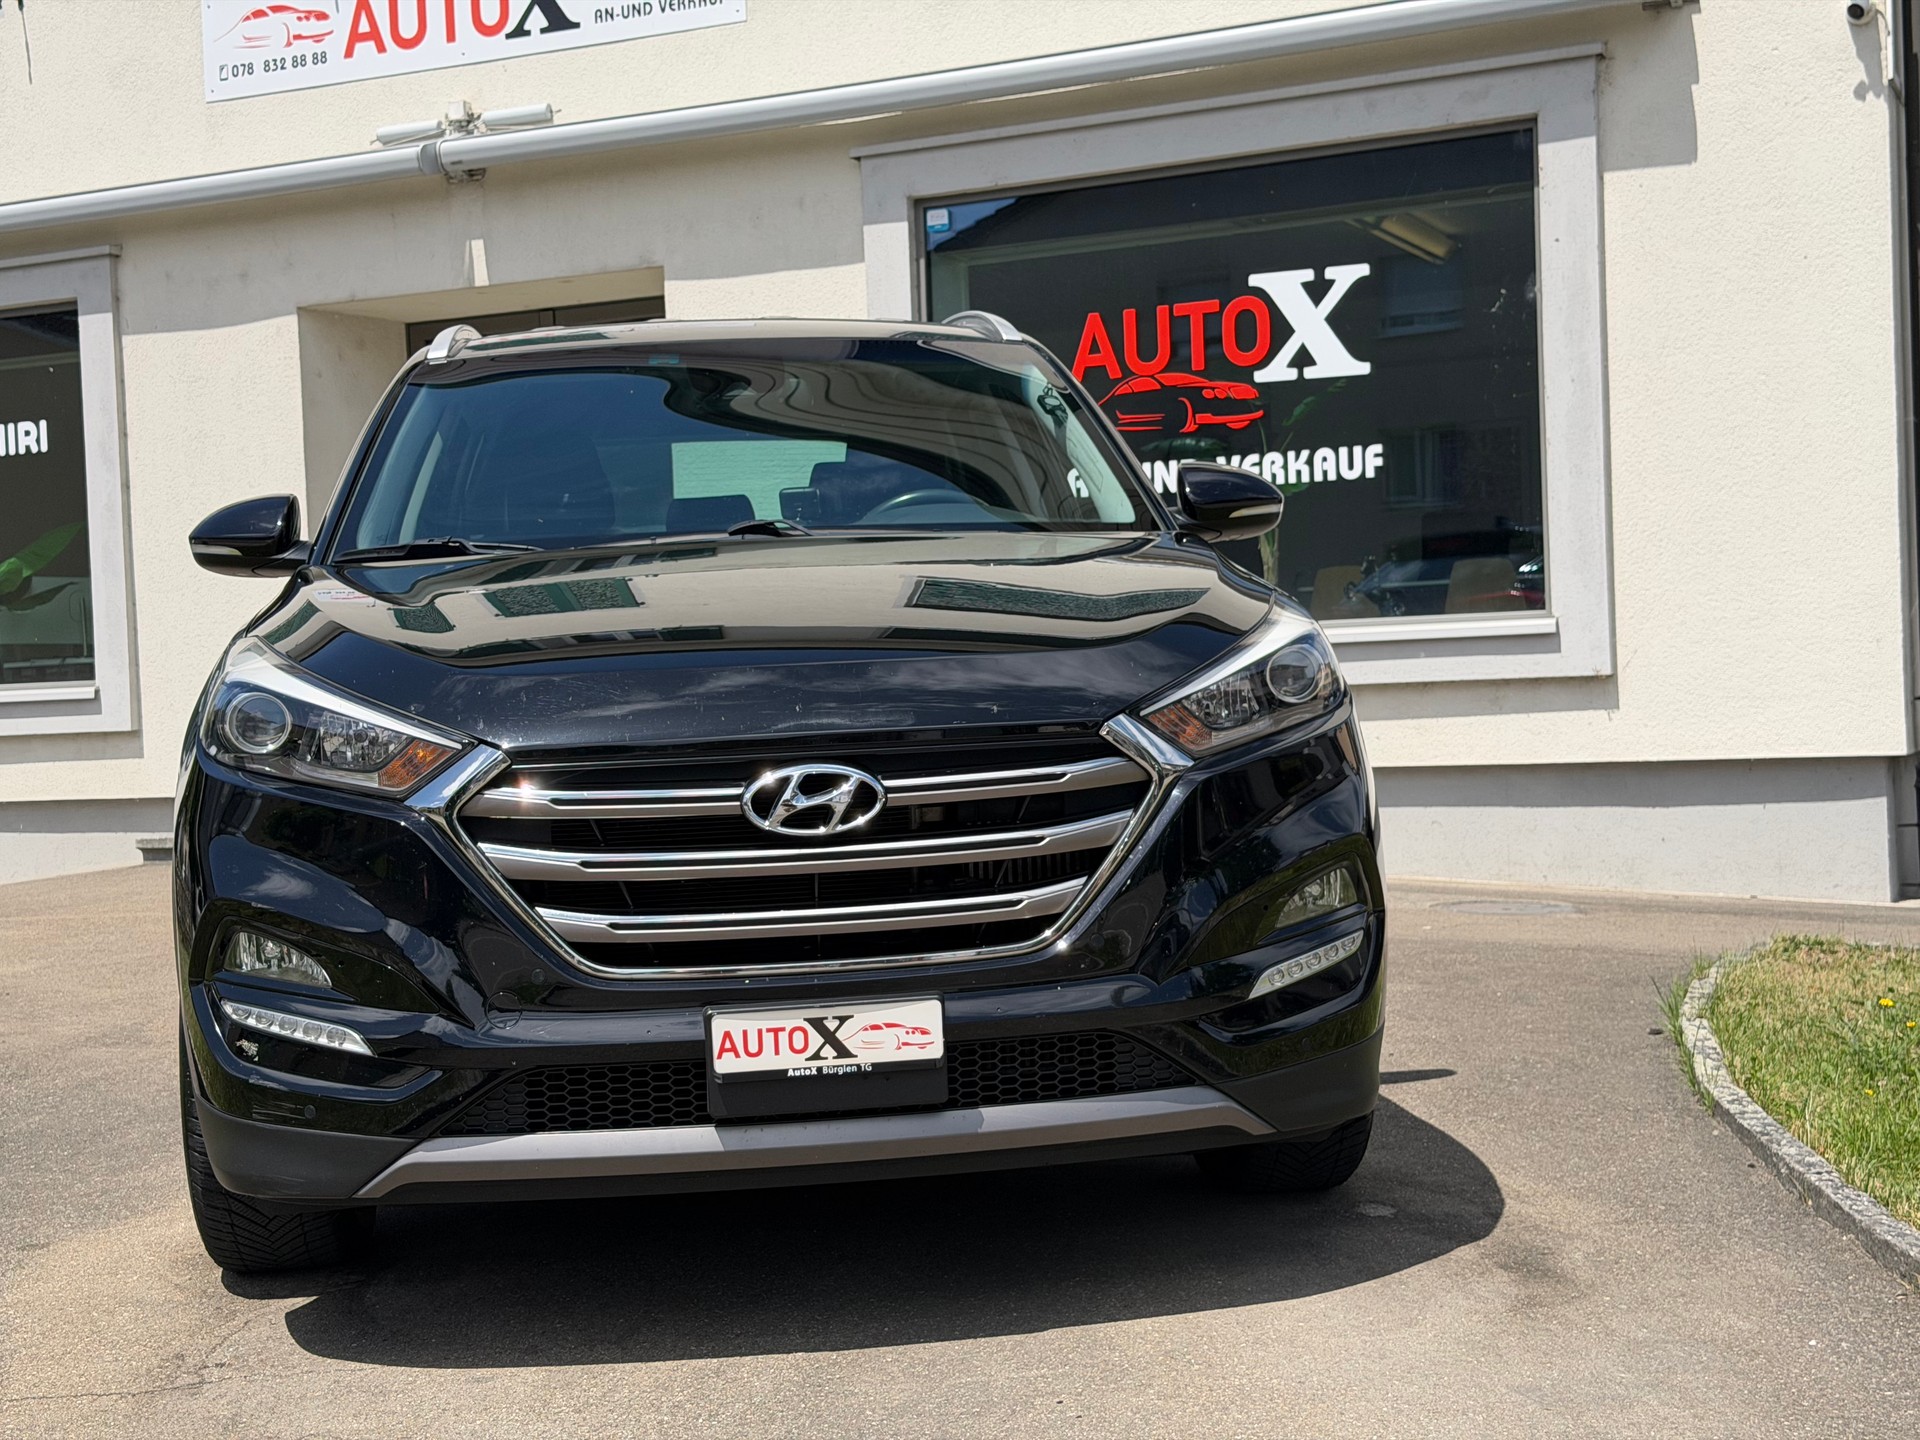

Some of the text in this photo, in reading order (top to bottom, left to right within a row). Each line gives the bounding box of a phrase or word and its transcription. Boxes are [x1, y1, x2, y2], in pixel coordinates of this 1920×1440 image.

[231, 51, 328, 78] 078 832 88 88
[1072, 263, 1371, 383] AUTOX
[0, 419, 48, 457] IRI
[716, 1014, 859, 1062] AUTOX
[787, 1063, 873, 1077] AutoX Bürglen TG
